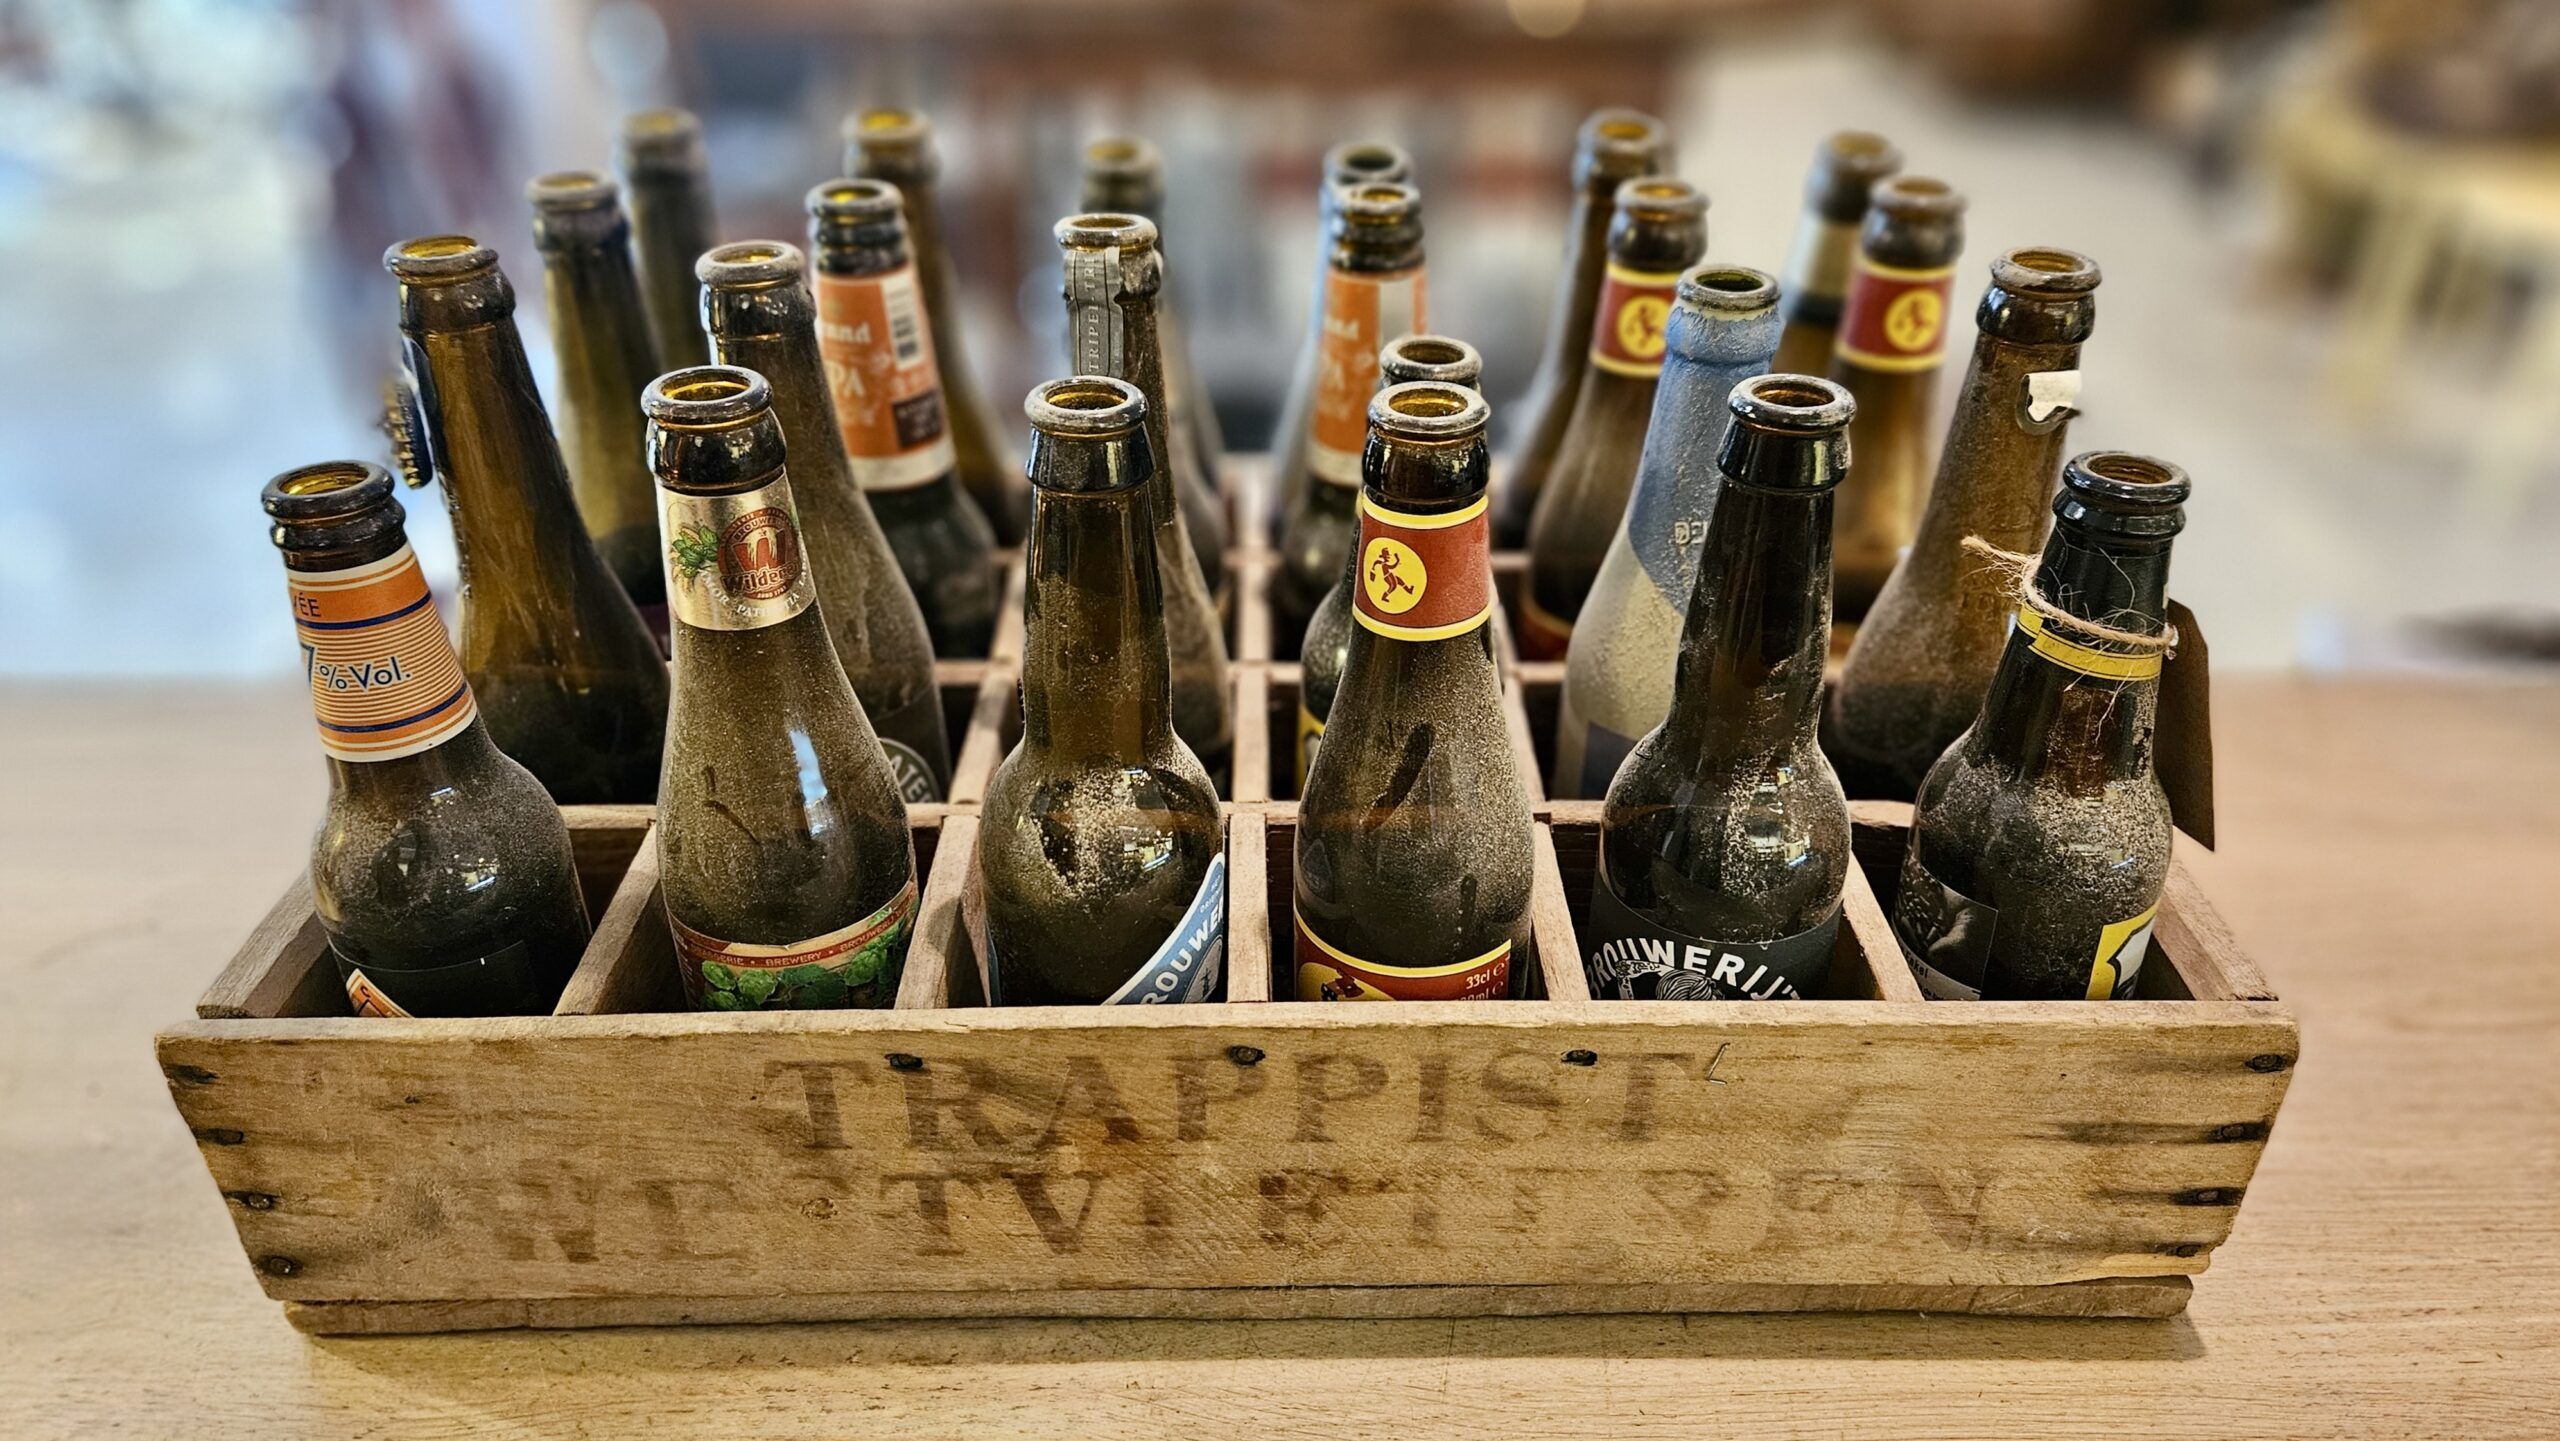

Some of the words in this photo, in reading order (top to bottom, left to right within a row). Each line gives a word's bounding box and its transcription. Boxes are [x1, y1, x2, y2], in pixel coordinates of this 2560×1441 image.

[765, 952, 823, 967] BREWERY
[1465, 968, 1491, 990] 33cl
[762, 1051, 1696, 1150] TRAPPIST
